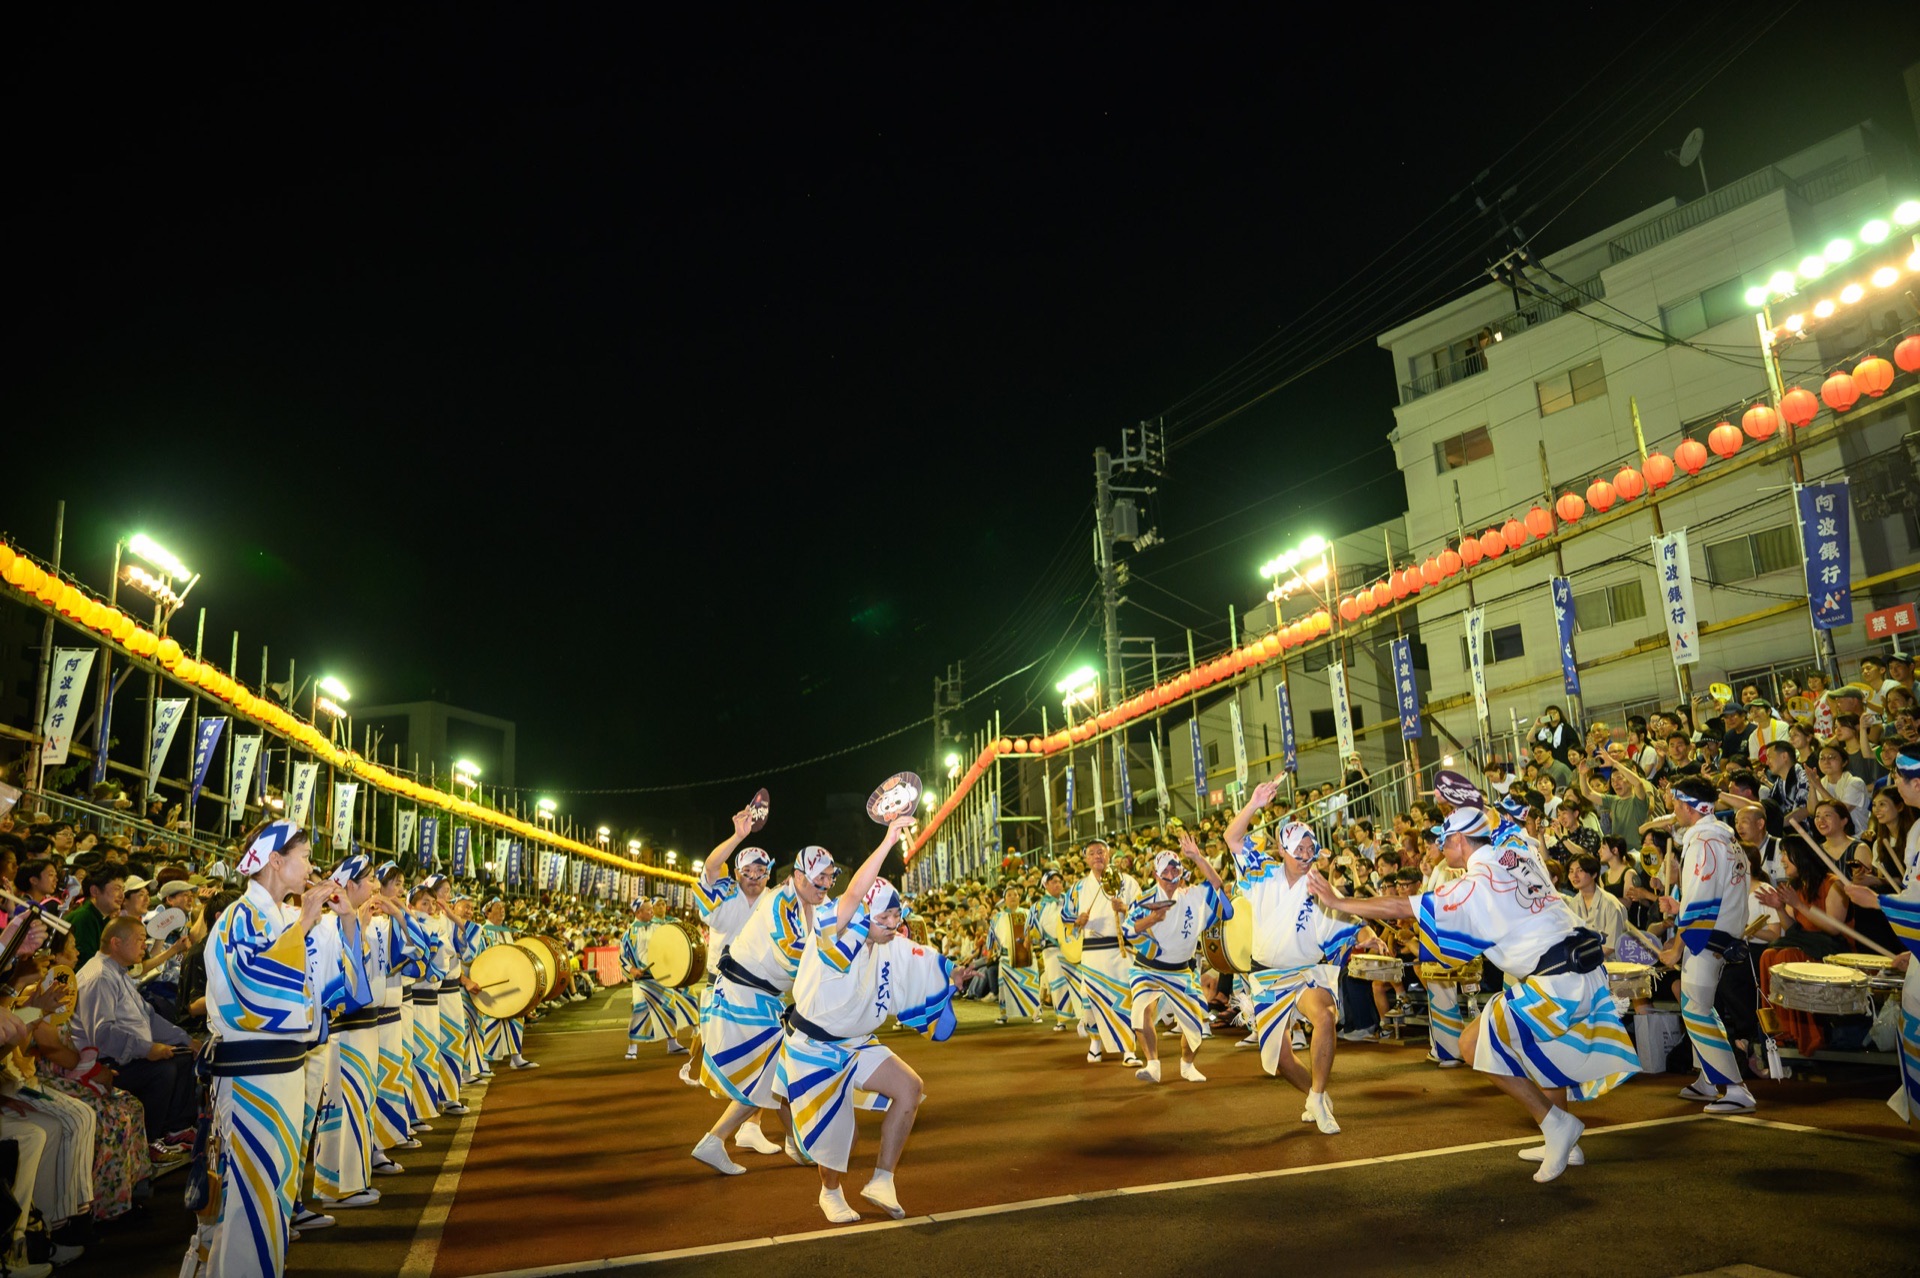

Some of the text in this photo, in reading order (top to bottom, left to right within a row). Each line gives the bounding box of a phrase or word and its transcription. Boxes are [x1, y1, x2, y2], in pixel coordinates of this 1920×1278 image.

[1815, 494, 1841, 584] 阿波銀行
[1664, 541, 1685, 625] 阿波銀行
[1872, 610, 1910, 632] 禁煙
[51, 657, 82, 728] 阿波銀行
[1399, 646, 1414, 710] 阿波銀行
[233, 743, 252, 795] 阿波銀行
[293, 768, 311, 814] 阿波銀行
[337, 789, 350, 829] 阿波銀行
